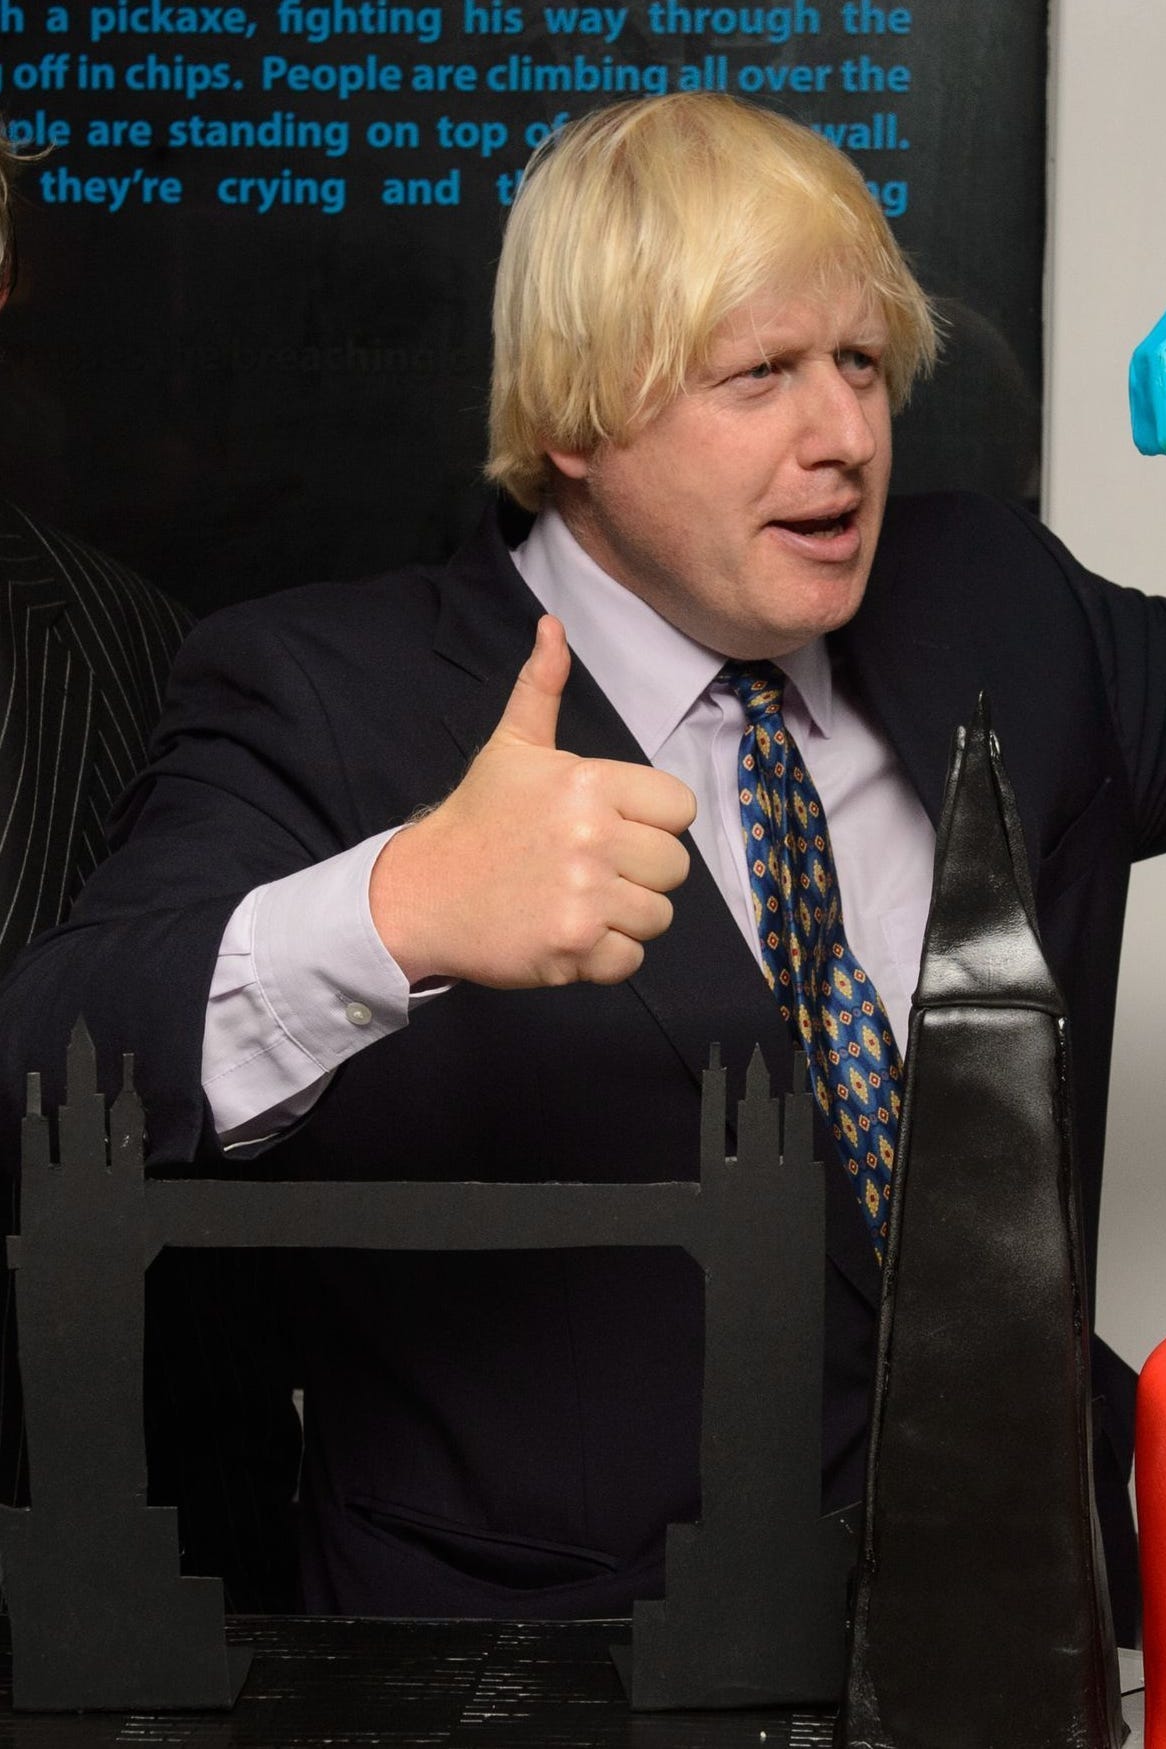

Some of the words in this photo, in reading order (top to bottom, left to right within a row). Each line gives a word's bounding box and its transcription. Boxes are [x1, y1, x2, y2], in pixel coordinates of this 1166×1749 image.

[45, 5, 69, 33] a
[90, 0, 257, 42] pickaxe,
[277, 0, 443, 43] fighting
[464, 0, 523, 35] his
[544, 6, 627, 43] way
[648, 0, 820, 44] through
[842, 0, 912, 34] the
[12, 51, 71, 91] off
[77, 52, 116, 91] in
[125, 53, 244, 100] chips.
[262, 54, 402, 100] People
[411, 64, 478, 92] are
[486, 54, 669, 98] climbing
[678, 54, 728, 92] all
[737, 64, 832, 93] over
[841, 55, 912, 93] the
[87, 119, 153, 148] are
[168, 110, 349, 157] standing
[366, 120, 420, 148] on
[436, 115, 508, 157] top
[217, 166, 347, 215] crying
[381, 168, 460, 206] and
